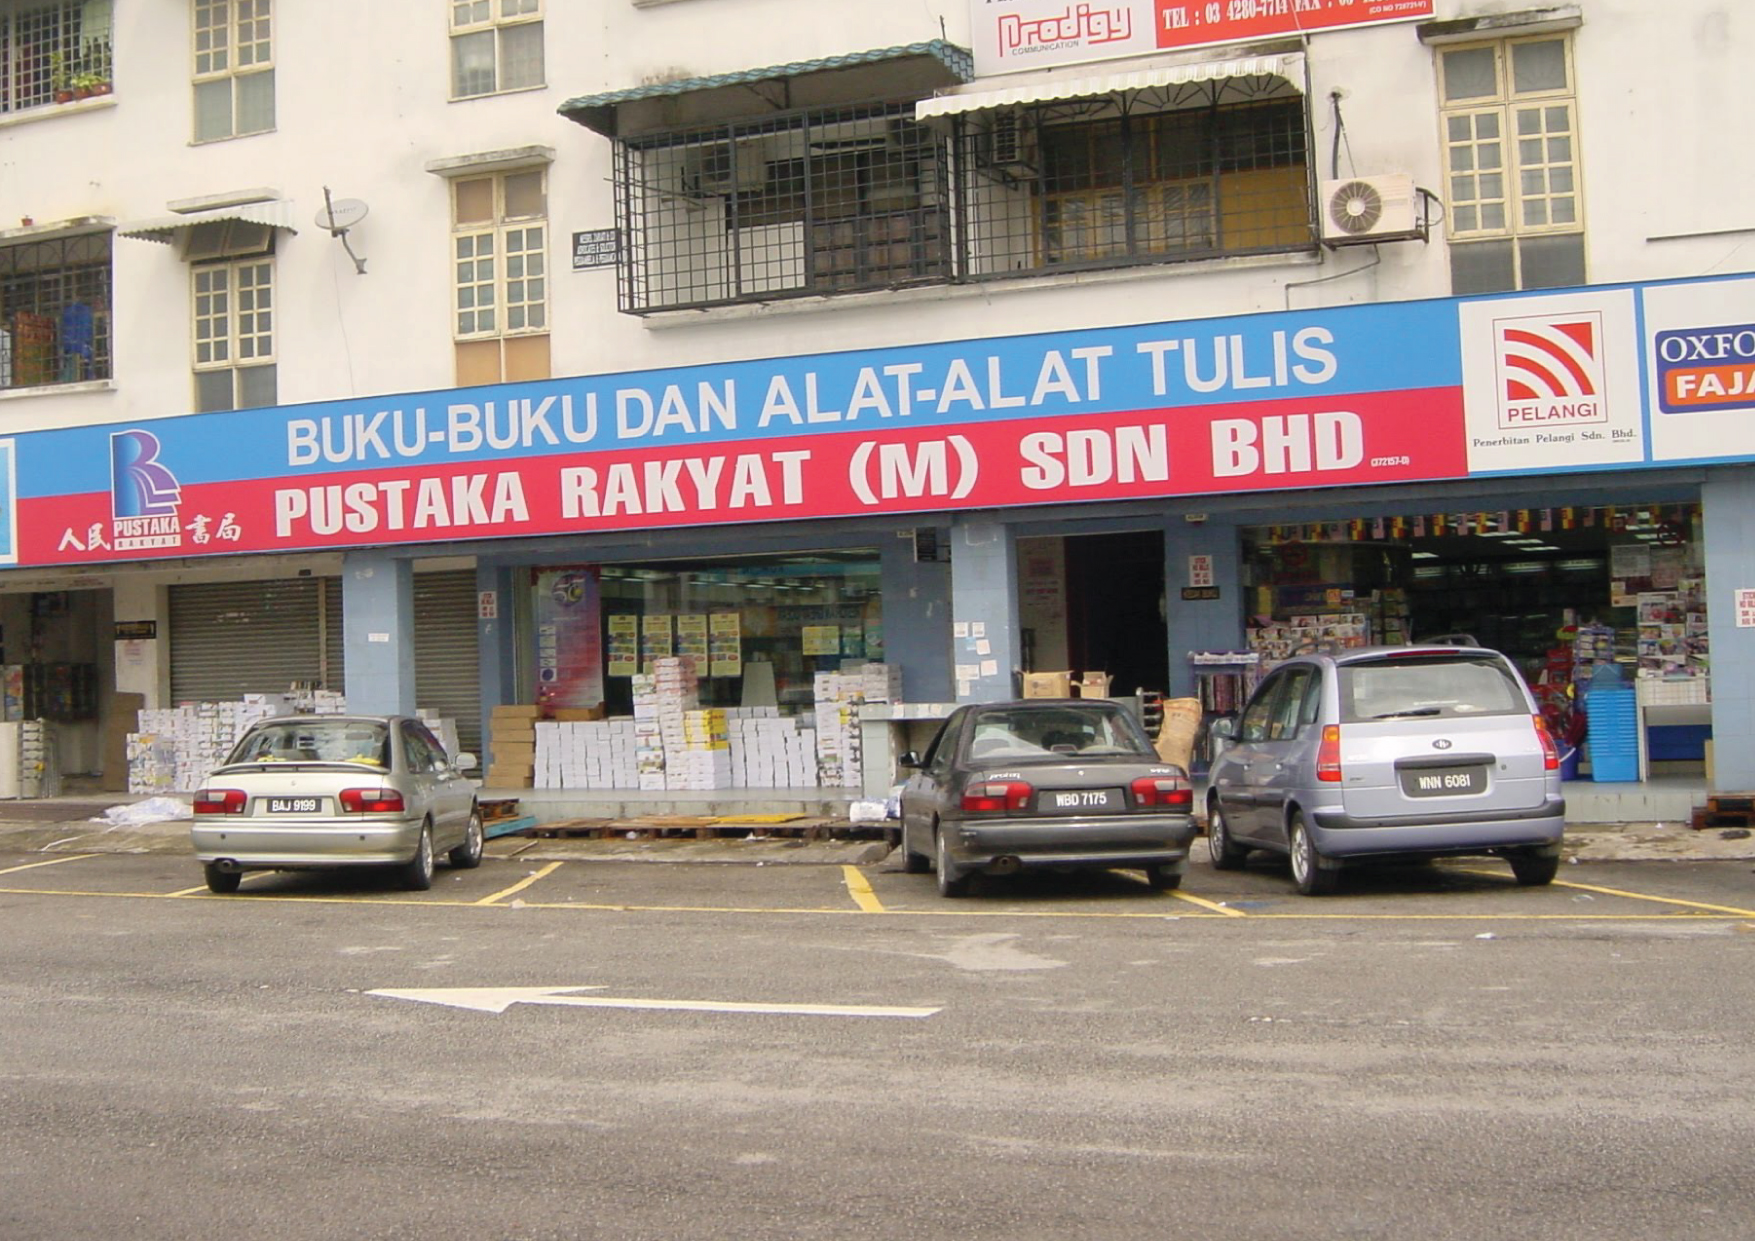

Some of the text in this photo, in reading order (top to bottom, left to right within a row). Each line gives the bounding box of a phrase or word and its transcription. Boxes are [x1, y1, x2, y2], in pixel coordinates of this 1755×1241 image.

[1163, 7, 1190, 30] TEL
[1205, 7, 1221, 24] 03
[998, 3, 1132, 57] Prodigy
[1011, 40, 1079, 56] COMMUNICATION
[286, 326, 1338, 467] BUKU-BUKU DAN ALAT-ALAT TULIS
[1507, 403, 1598, 422] PELANGI
[1473, 428, 1637, 448] Penerbitan Pelangi Sdn. Bhd.
[274, 410, 1364, 537] PUSTAKA RAKYAT (M) SDN BHD
[58, 522, 112, 551] 人民
[113, 516, 181, 537] PUSTAKA
[117, 537, 178, 549] RAKYAT
[1418, 774, 1471, 790] WNN 6081
[272, 799, 316, 812] BAJ 9199
[1055, 792, 1107, 807] WBD 7175
